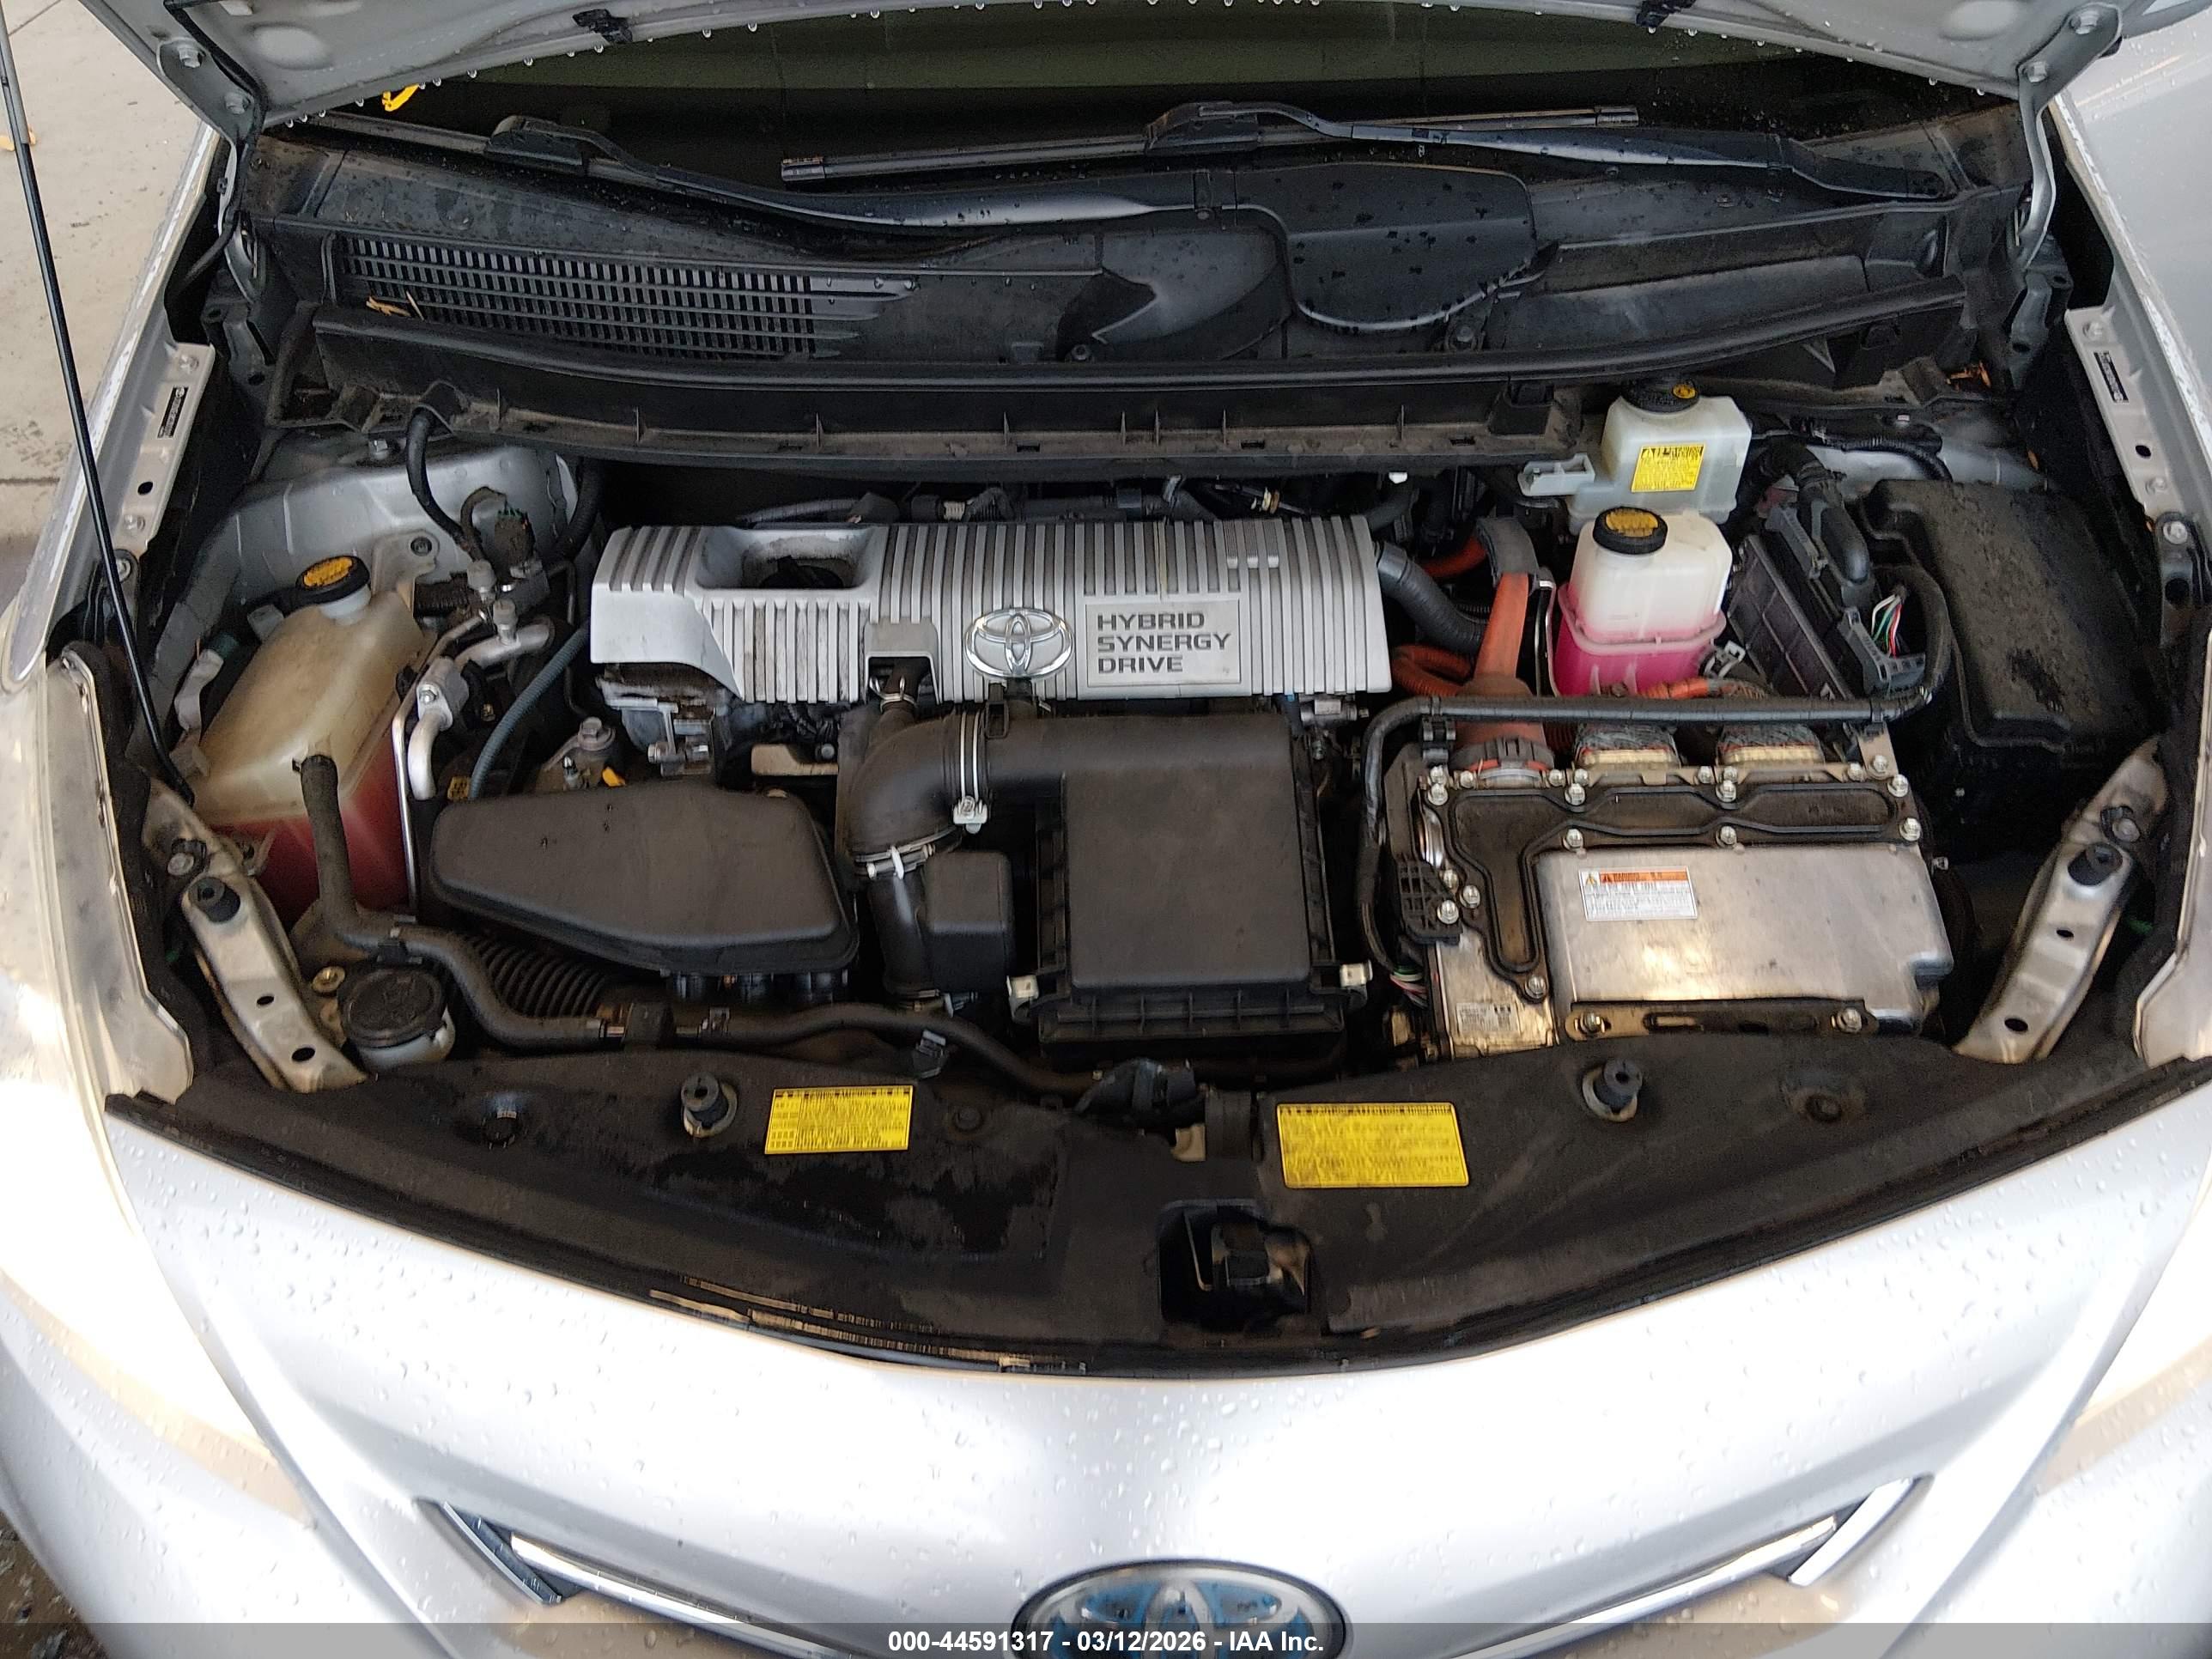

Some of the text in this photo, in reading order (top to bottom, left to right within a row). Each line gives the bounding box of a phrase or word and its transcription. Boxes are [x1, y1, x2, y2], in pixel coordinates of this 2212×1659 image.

[1097, 612, 1205, 631] HYBRID
[1097, 633, 1231, 653] SYNERGY
[1097, 655, 1183, 674] DRIVE
